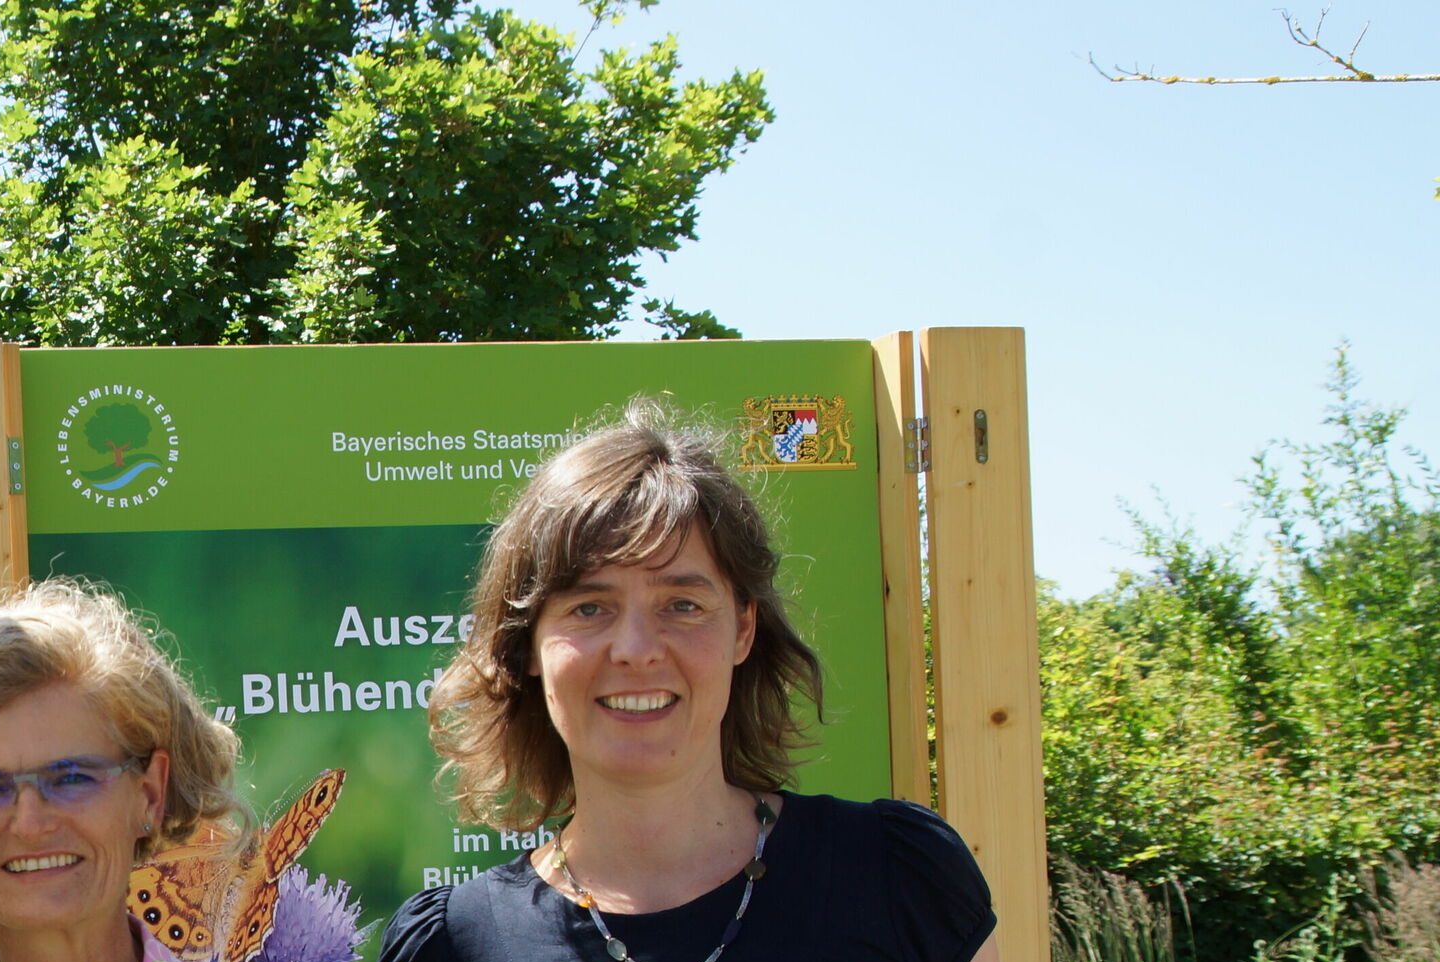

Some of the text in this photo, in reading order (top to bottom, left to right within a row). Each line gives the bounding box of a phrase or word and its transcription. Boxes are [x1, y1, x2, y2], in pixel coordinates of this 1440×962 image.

[58, 385, 179, 464] LEBENSMINISTERIUM
[332, 431, 466, 456] Bayerisches
[365, 461, 453, 482] Umwelt
[461, 459, 502, 480] und
[71, 476, 168, 508] BAYERN.DE
[334, 606, 477, 647] Ausze
[214, 667, 444, 721] „Blühend
[453, 825, 555, 852] im Rah
